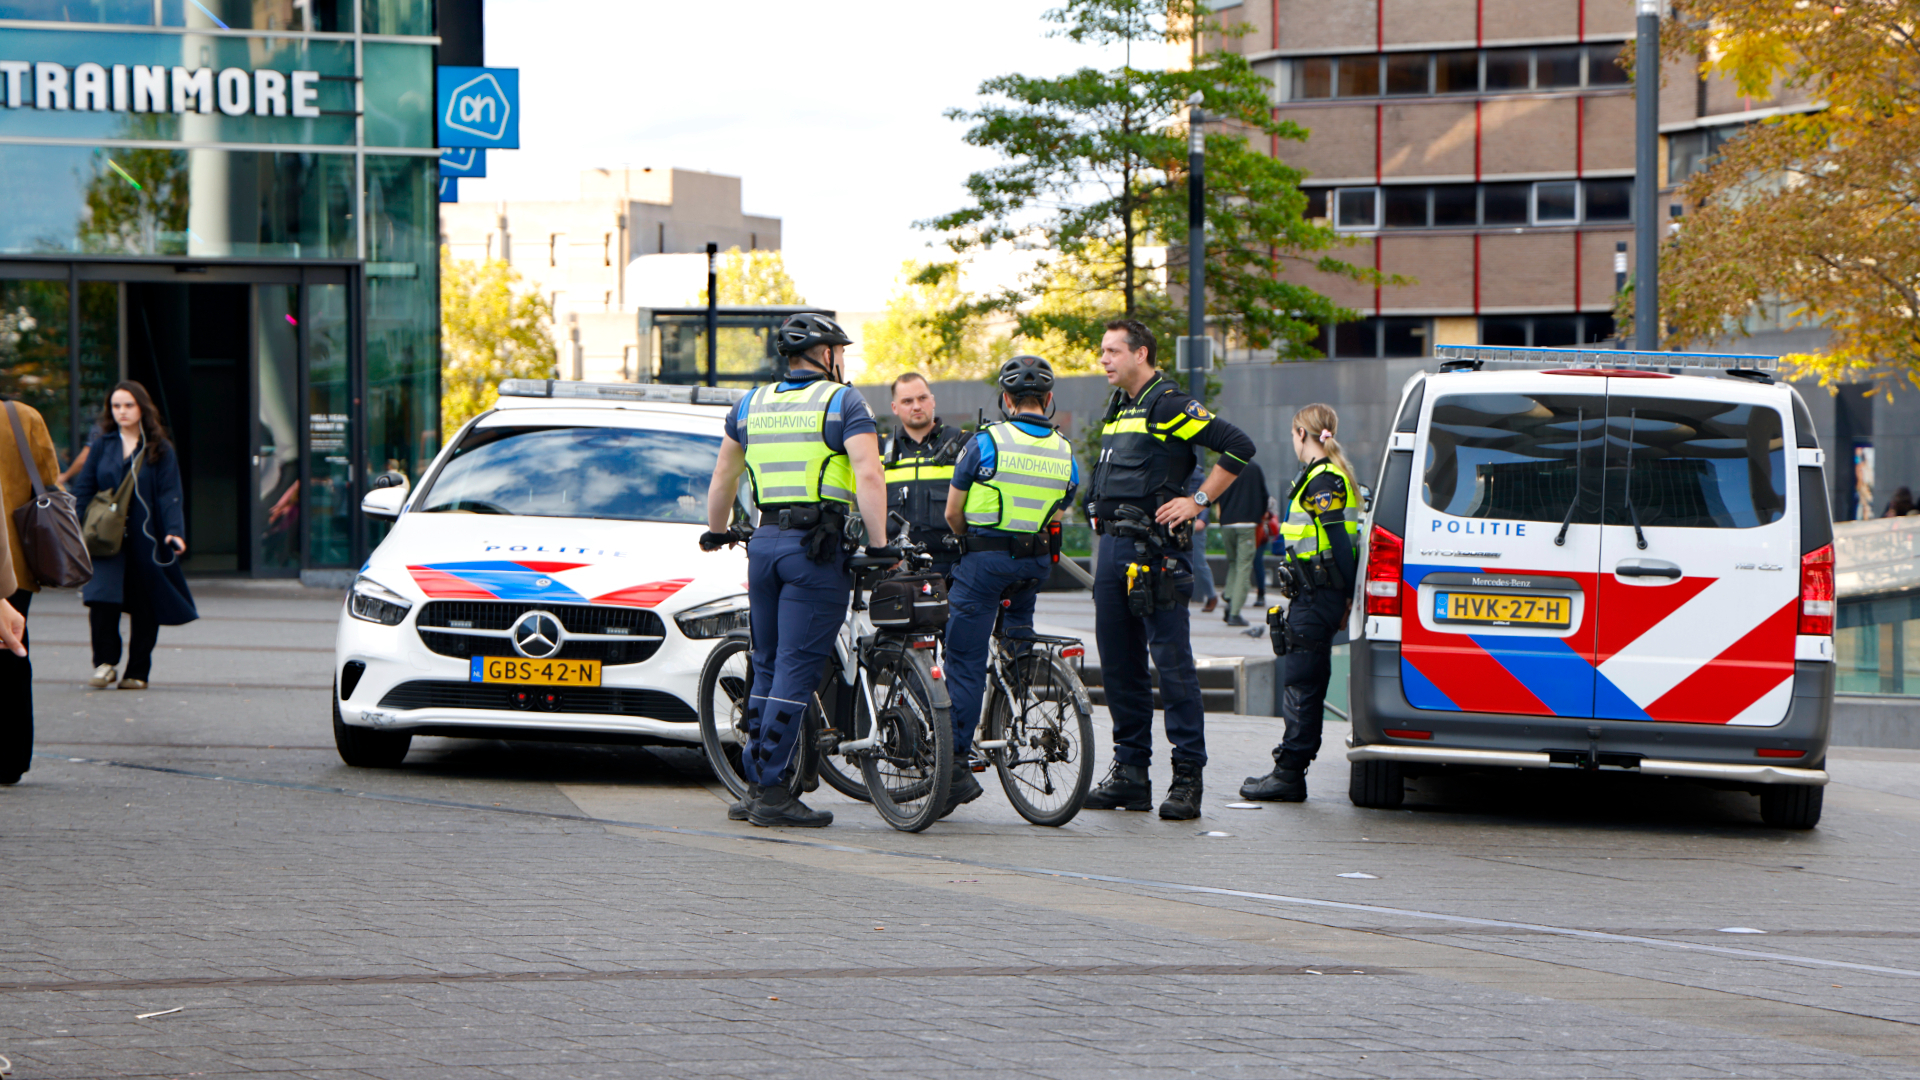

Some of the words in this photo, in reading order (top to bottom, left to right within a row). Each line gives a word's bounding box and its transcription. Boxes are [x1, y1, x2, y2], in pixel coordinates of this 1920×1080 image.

[0, 60, 320, 117] TRAINMORE
[749, 415, 816, 429] HANDHAVING
[1000, 454, 1071, 477] HANDHAVING
[1431, 519, 1526, 537] POLITIE
[485, 545, 628, 558] POLITIE
[1472, 577, 1531, 587] Mercedes-Benz
[1454, 597, 1560, 620] HVK-27-H
[473, 670, 481, 678] NL
[489, 660, 593, 682] GBS-42-N
